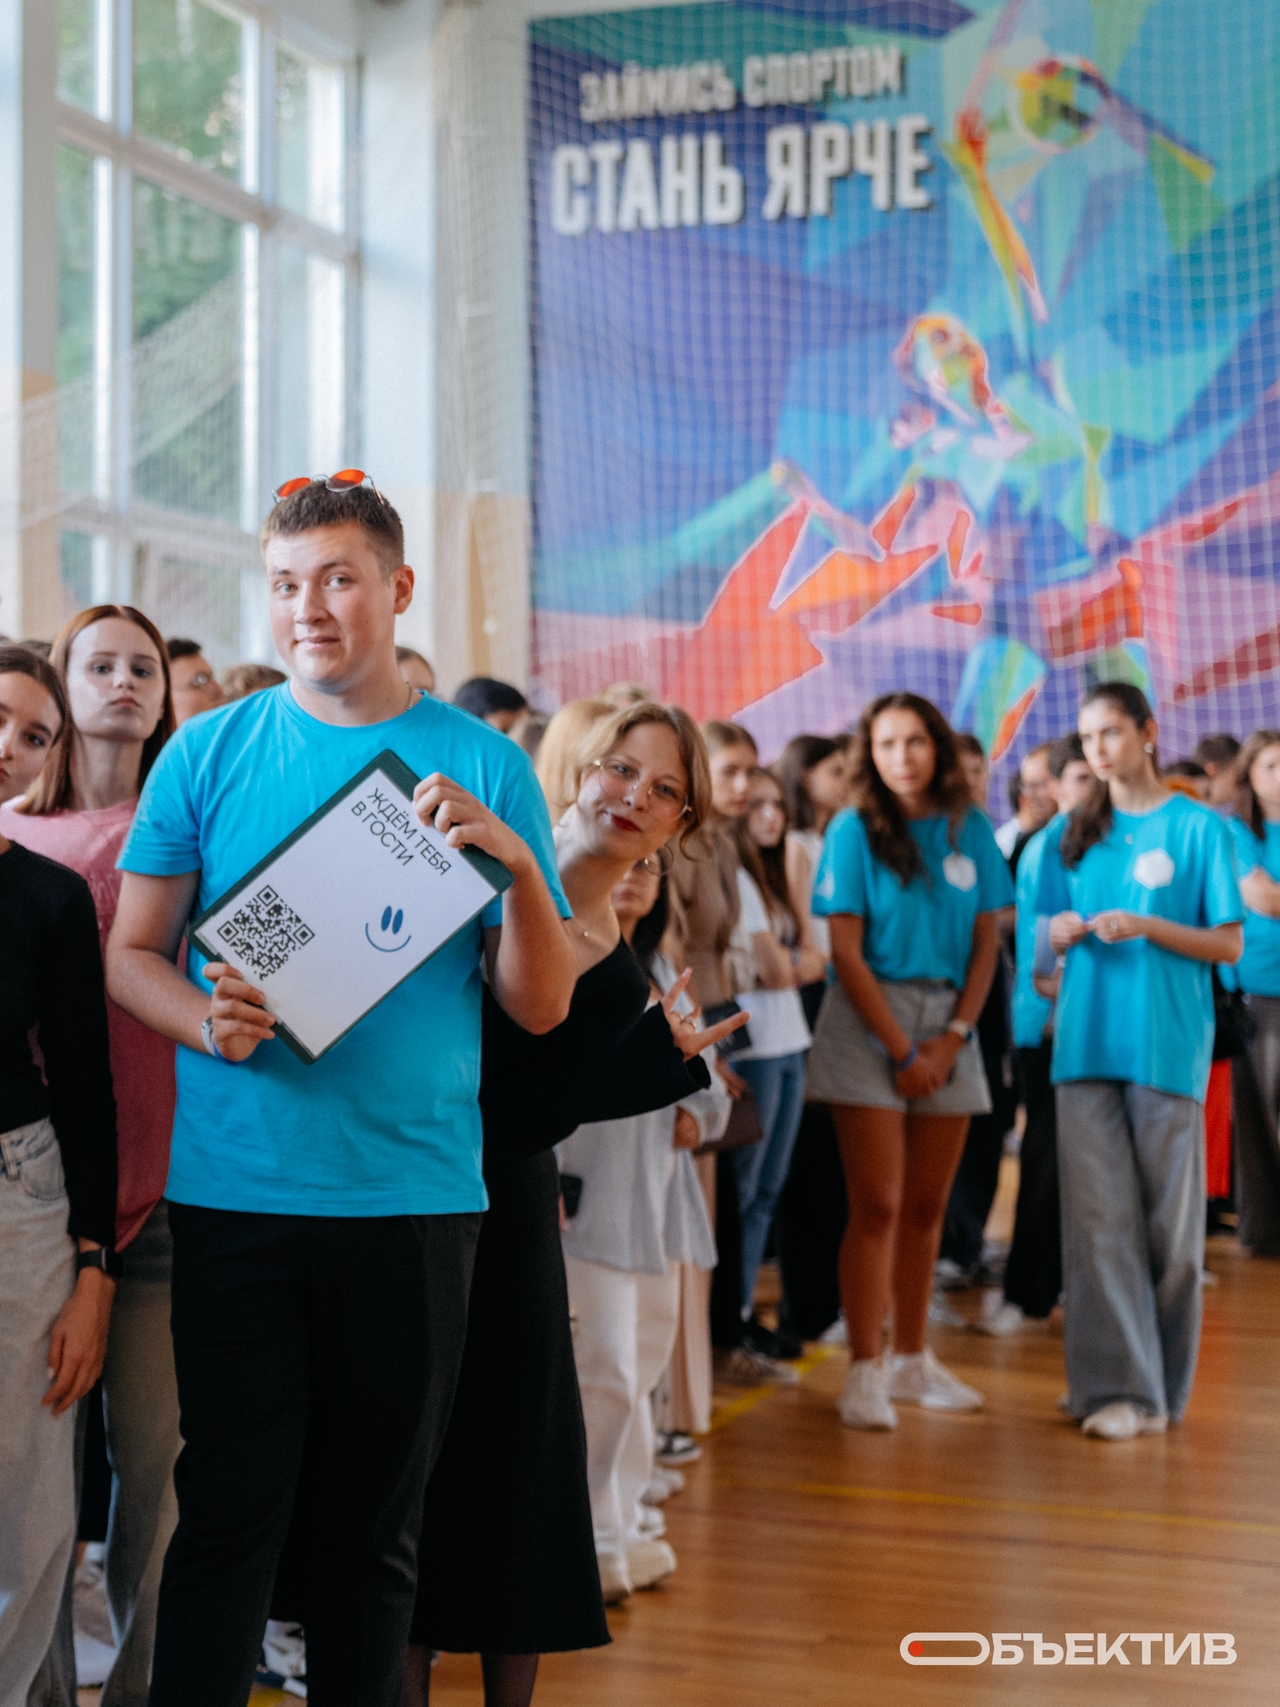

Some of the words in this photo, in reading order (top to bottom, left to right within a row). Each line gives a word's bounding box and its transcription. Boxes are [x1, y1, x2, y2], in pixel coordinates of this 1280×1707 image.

[578, 60, 737, 124] ЗАЙМИСЬ
[743, 44, 904, 108] СПОРТОМ
[551, 131, 744, 236] СТАНЬ
[762, 114, 932, 221] ЯРЧЕ
[350, 800, 367, 817] В
[361, 811, 415, 866] ГОСТИ
[366, 787, 418, 841] ЖДЁМ
[416, 834, 452, 876] ТЕБЯ
